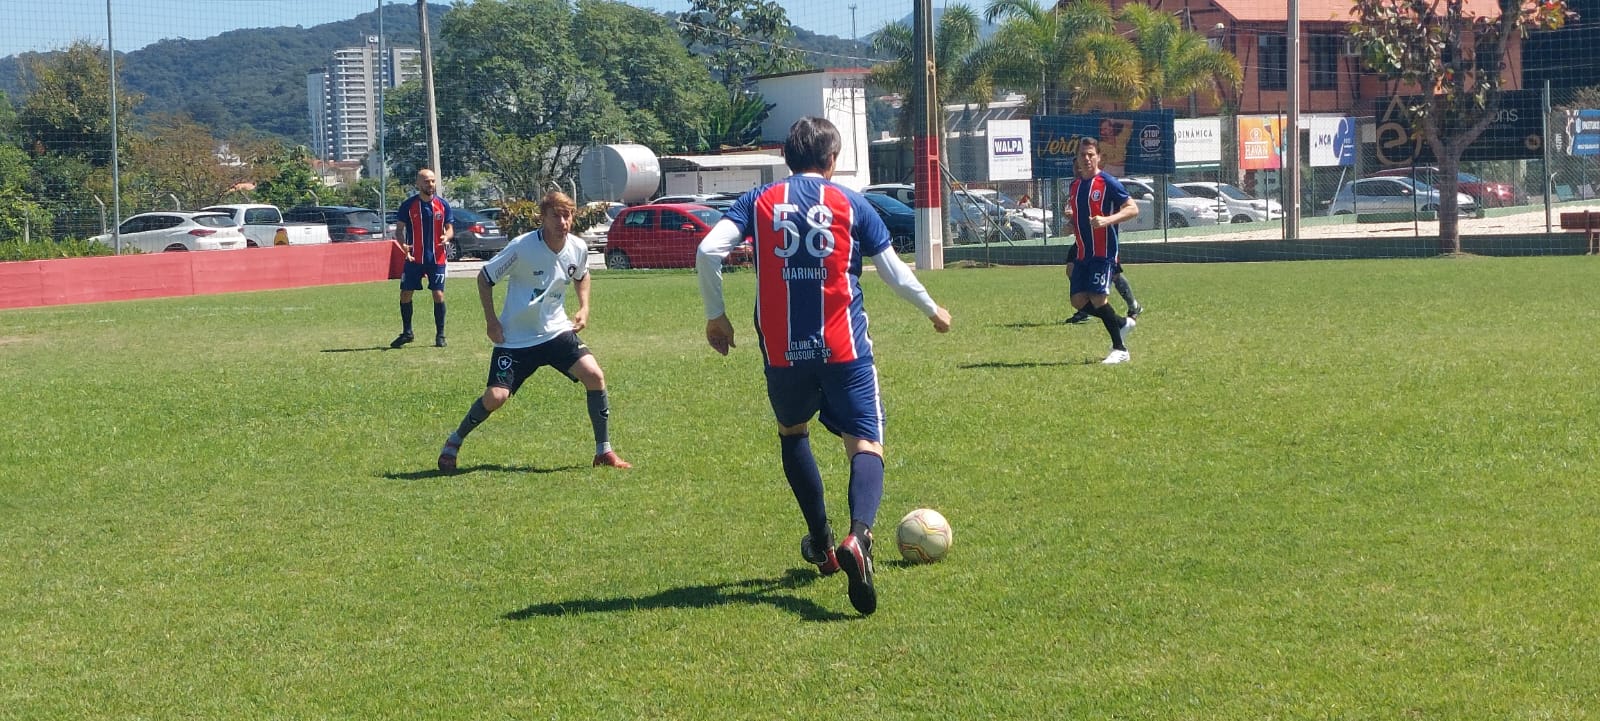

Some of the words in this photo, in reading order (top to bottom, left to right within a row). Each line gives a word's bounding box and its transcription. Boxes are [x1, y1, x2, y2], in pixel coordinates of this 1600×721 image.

[1143, 129, 1160, 138] STOP
[994, 139, 1023, 153] WALPA
[1143, 139, 1161, 148] SHOP
[1245, 144, 1269, 157] HAVAN
[773, 203, 835, 258] 58
[435, 273, 445, 284] 77
[782, 267, 828, 281] MARINHO
[790, 341, 811, 351] CLUBE
[784, 350, 816, 361] BRUSQUE
[821, 348, 831, 358] SC
